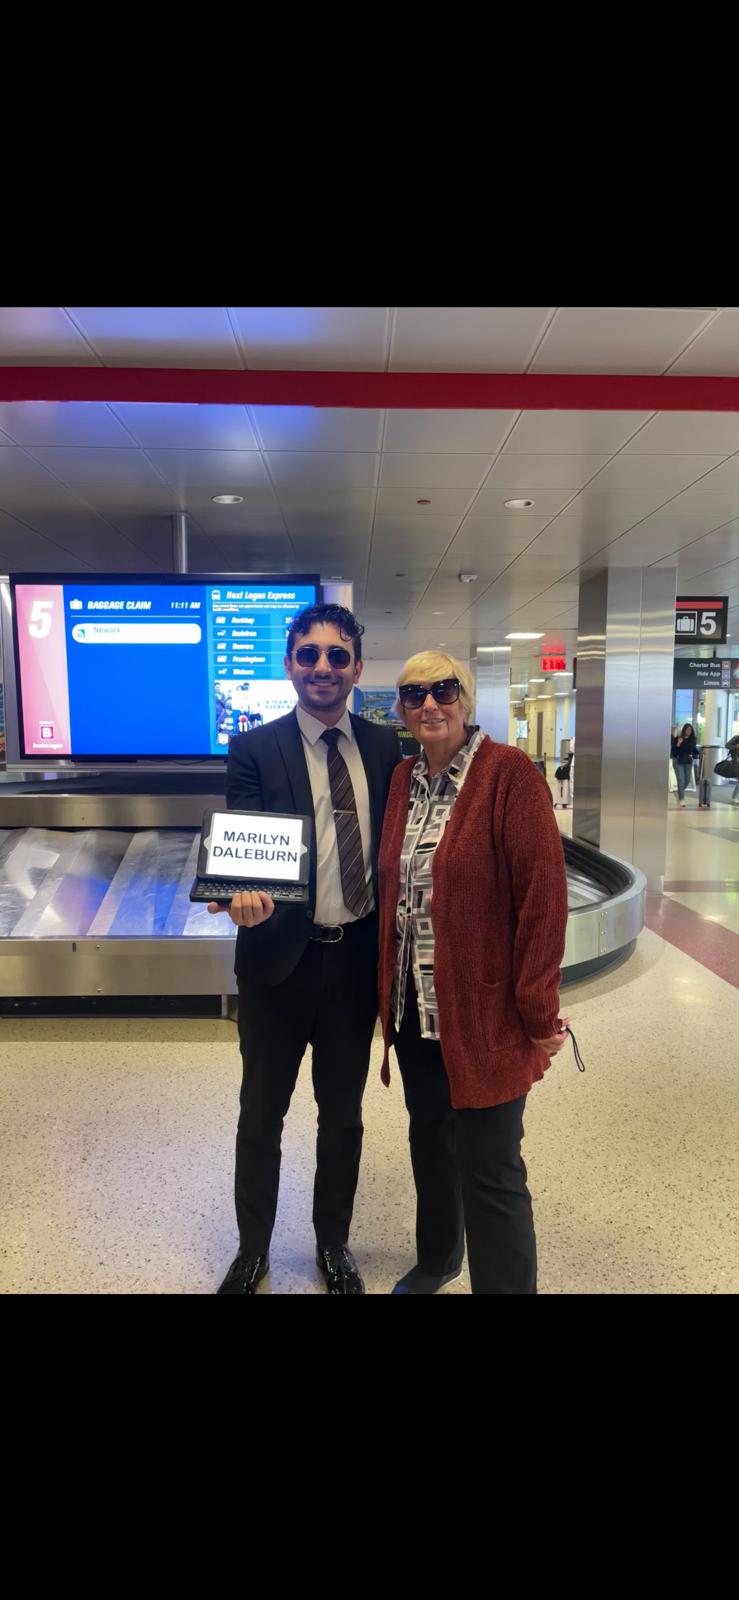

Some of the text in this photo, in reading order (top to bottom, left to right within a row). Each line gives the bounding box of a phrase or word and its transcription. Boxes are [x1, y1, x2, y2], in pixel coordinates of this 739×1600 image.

[226, 591, 296, 601] Next Logan Express
[87, 601, 151, 610] BAGGAGE CLAIM
[29, 600, 54, 638] 5
[700, 611, 717, 635] 5
[42, 727, 52, 738] B
[223, 831, 290, 846] MARILYN
[213, 846, 298, 862] DALEBURN
